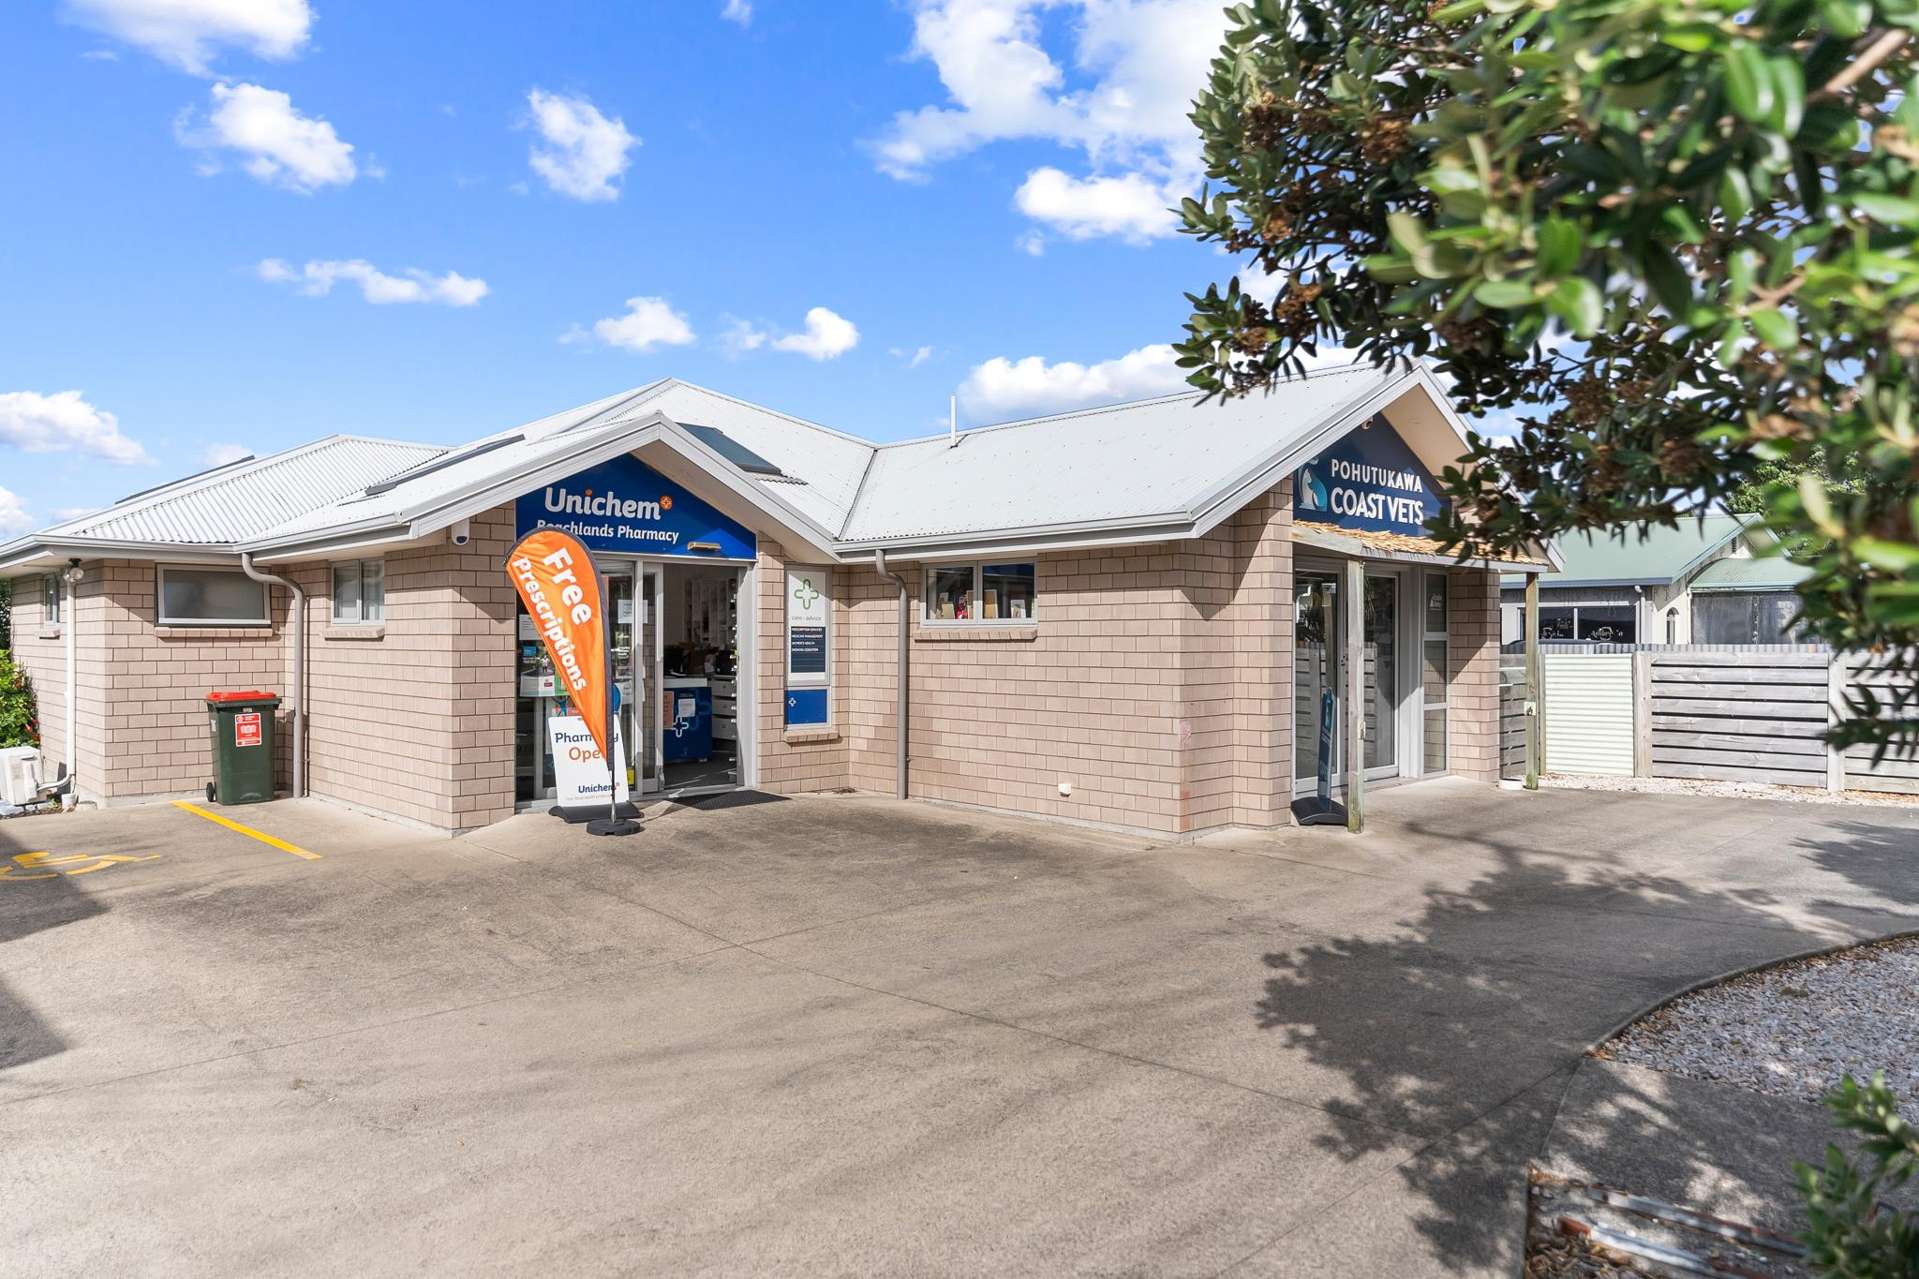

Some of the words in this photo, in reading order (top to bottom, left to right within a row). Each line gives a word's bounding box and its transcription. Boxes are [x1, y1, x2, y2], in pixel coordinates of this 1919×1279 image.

[1331, 458, 1423, 493] POHUTUKAWA
[544, 487, 661, 521] Unichem
[1331, 486, 1385, 519] COAST
[1387, 495, 1424, 526] VETS
[617, 525, 679, 545] Pharmacy
[543, 547, 592, 625] Free
[511, 556, 587, 691] Prescriptions
[569, 746, 601, 763] Ope
